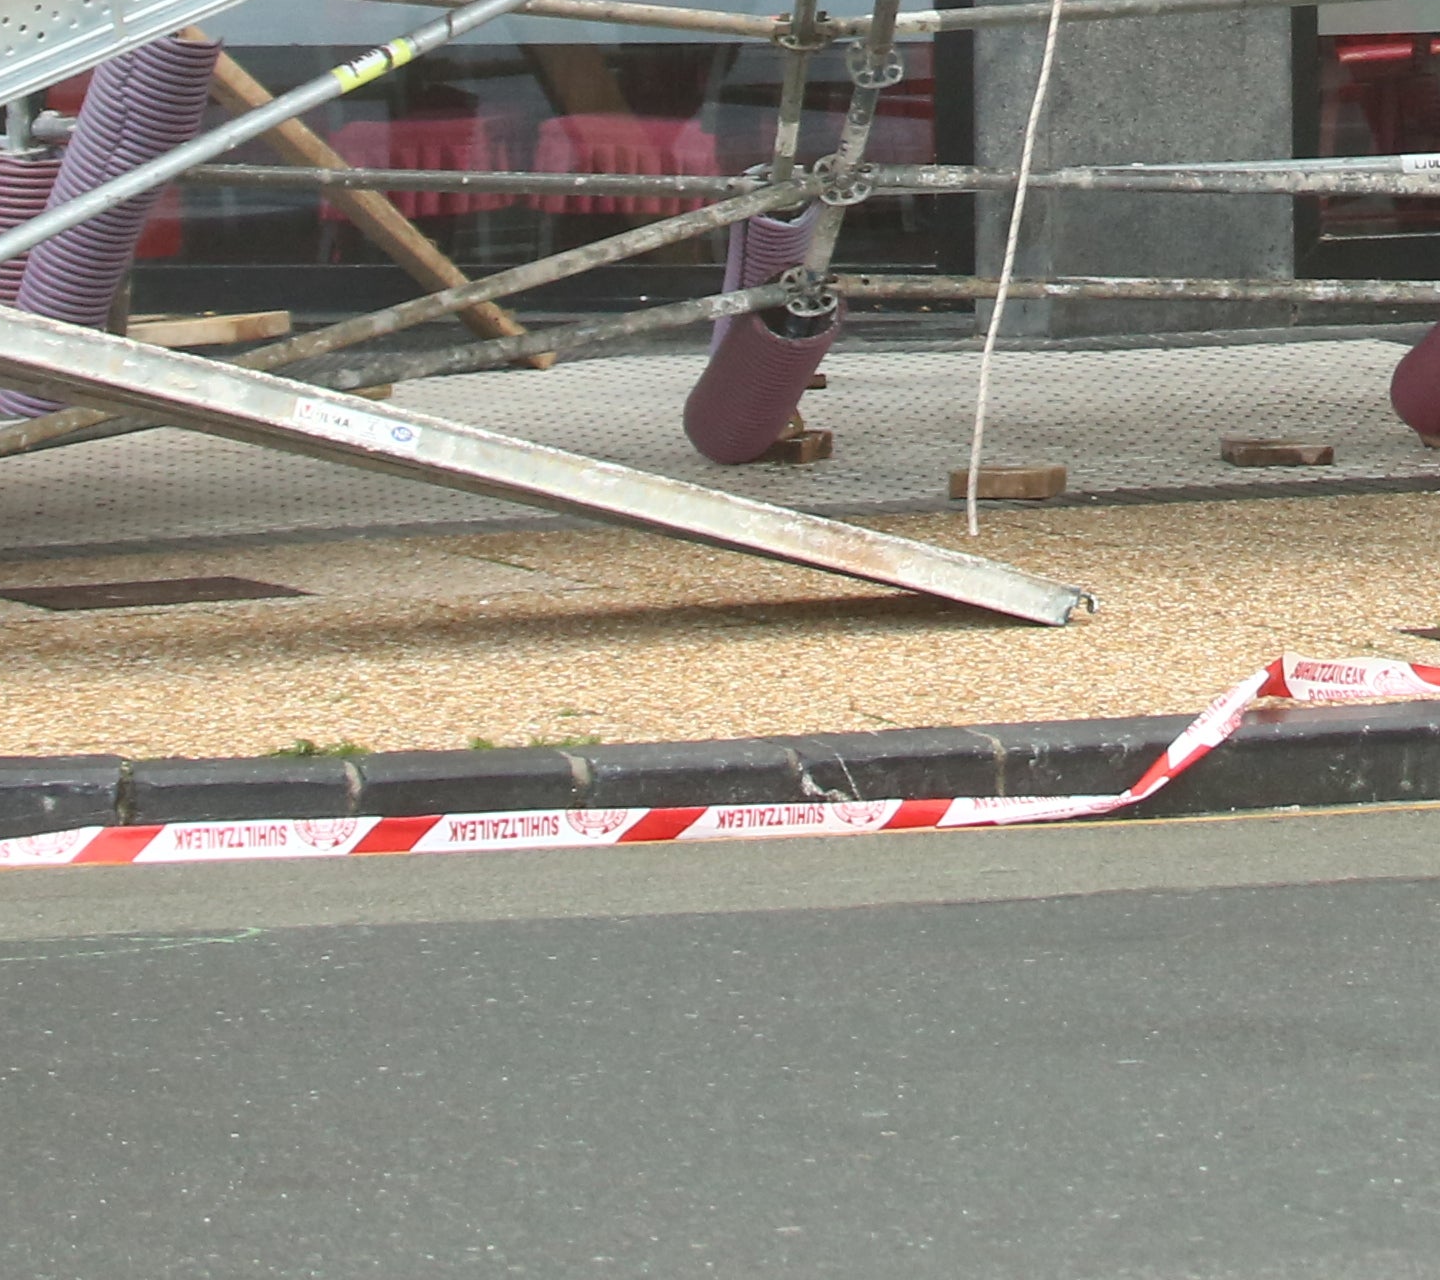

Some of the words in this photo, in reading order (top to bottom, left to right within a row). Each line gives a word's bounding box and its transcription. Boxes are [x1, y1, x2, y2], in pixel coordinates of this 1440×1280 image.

[717, 804, 826, 829] SUHILTZAILEAK
[173, 825, 289, 849] SUHILTZAILEAK
[450, 816, 560, 843] SUHILTZAILEAK
